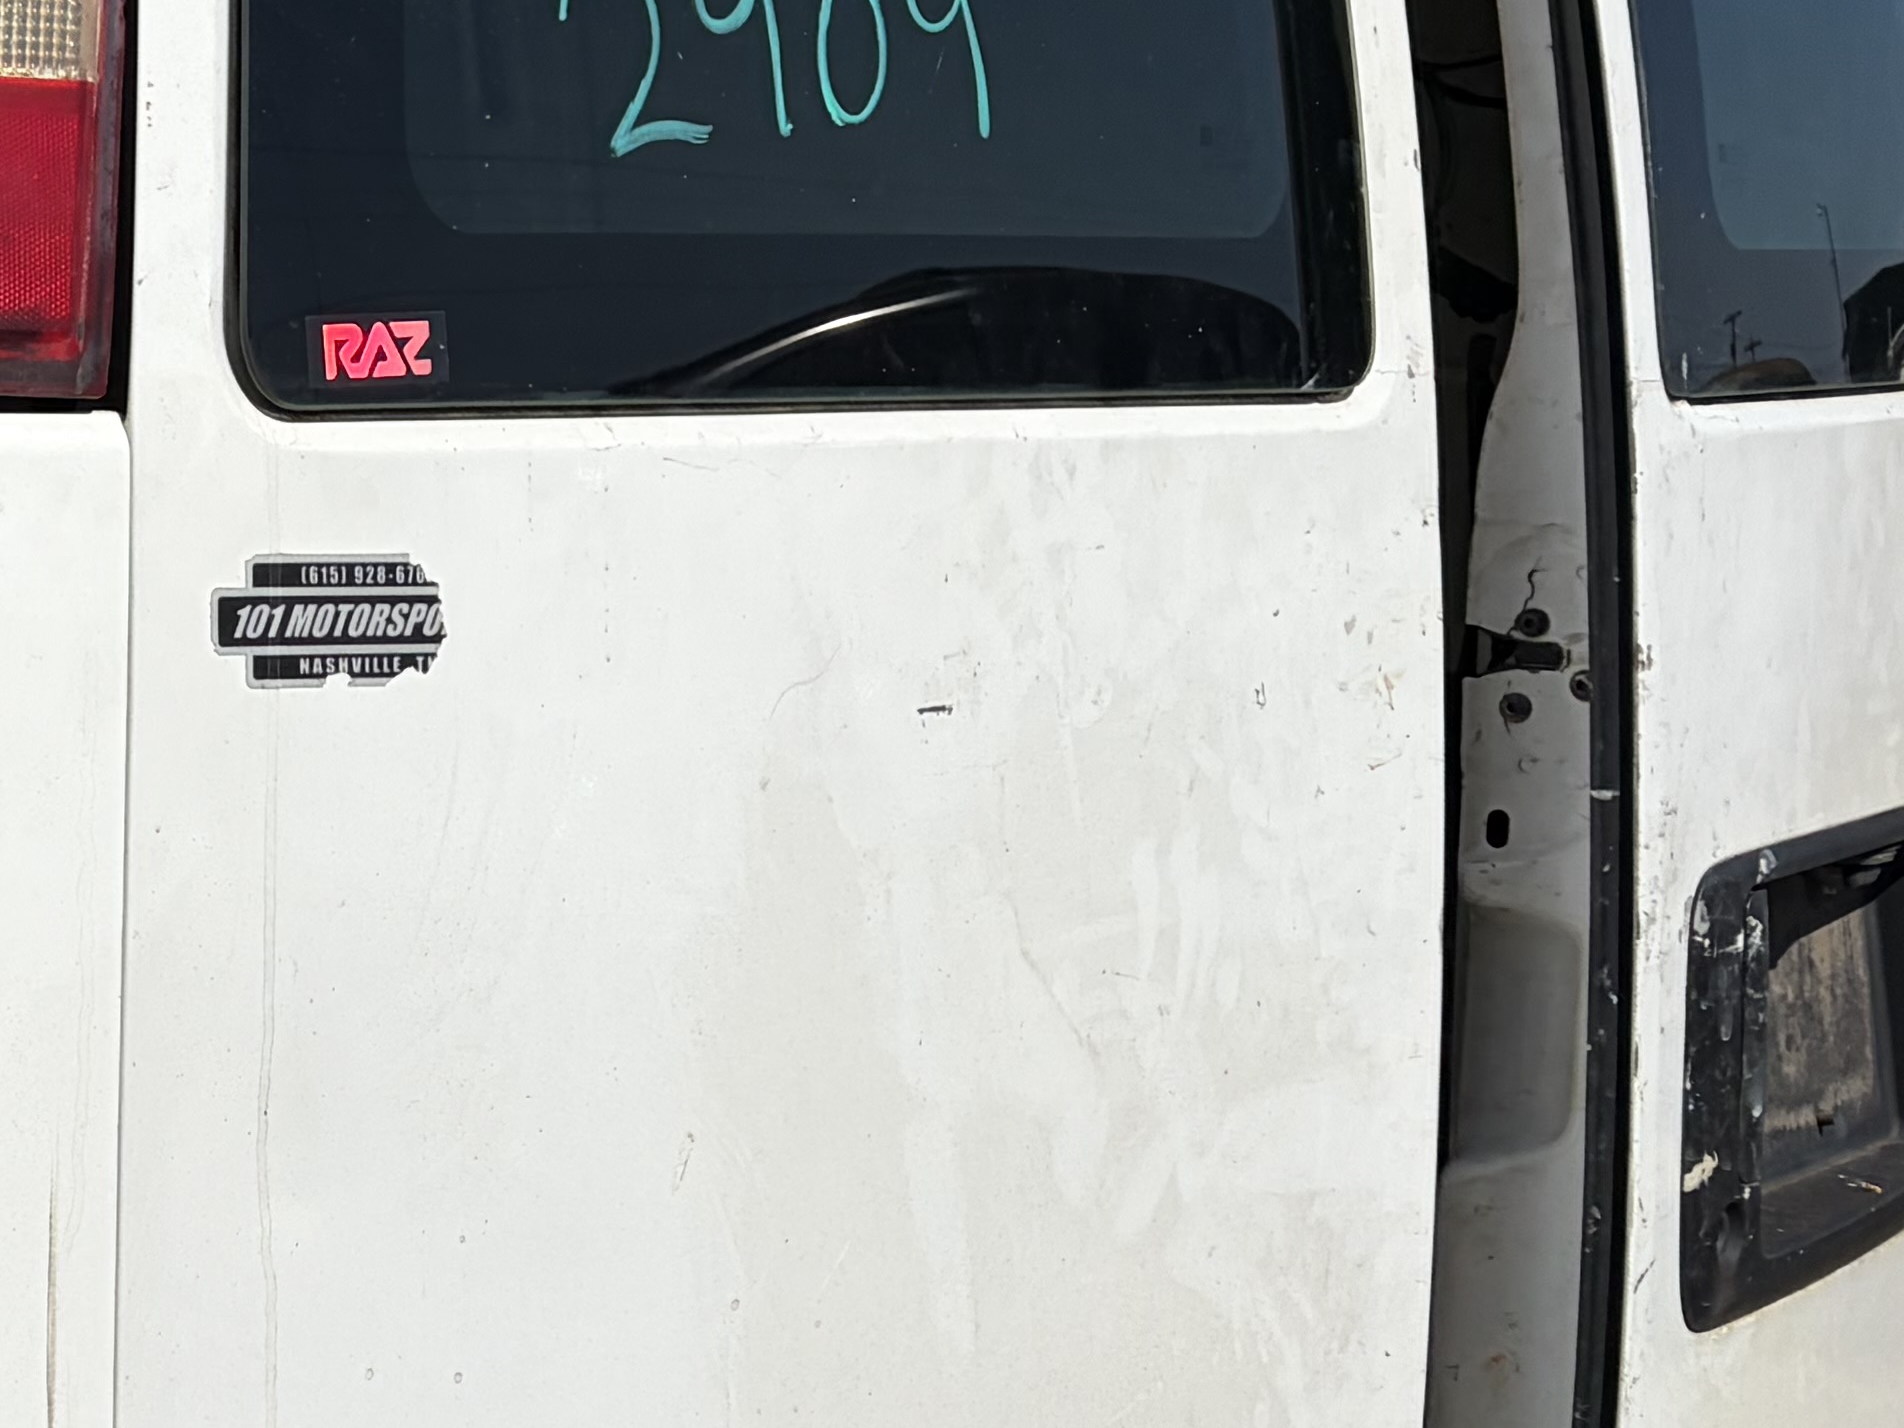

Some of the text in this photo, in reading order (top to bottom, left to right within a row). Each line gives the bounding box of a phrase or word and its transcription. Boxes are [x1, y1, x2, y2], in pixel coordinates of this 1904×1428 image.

[321, 319, 433, 381] RAZ
[300, 565, 347, 585] (615)
[233, 602, 447, 639] 101 MOTORSPO
[299, 656, 402, 675] NASHVILLE
